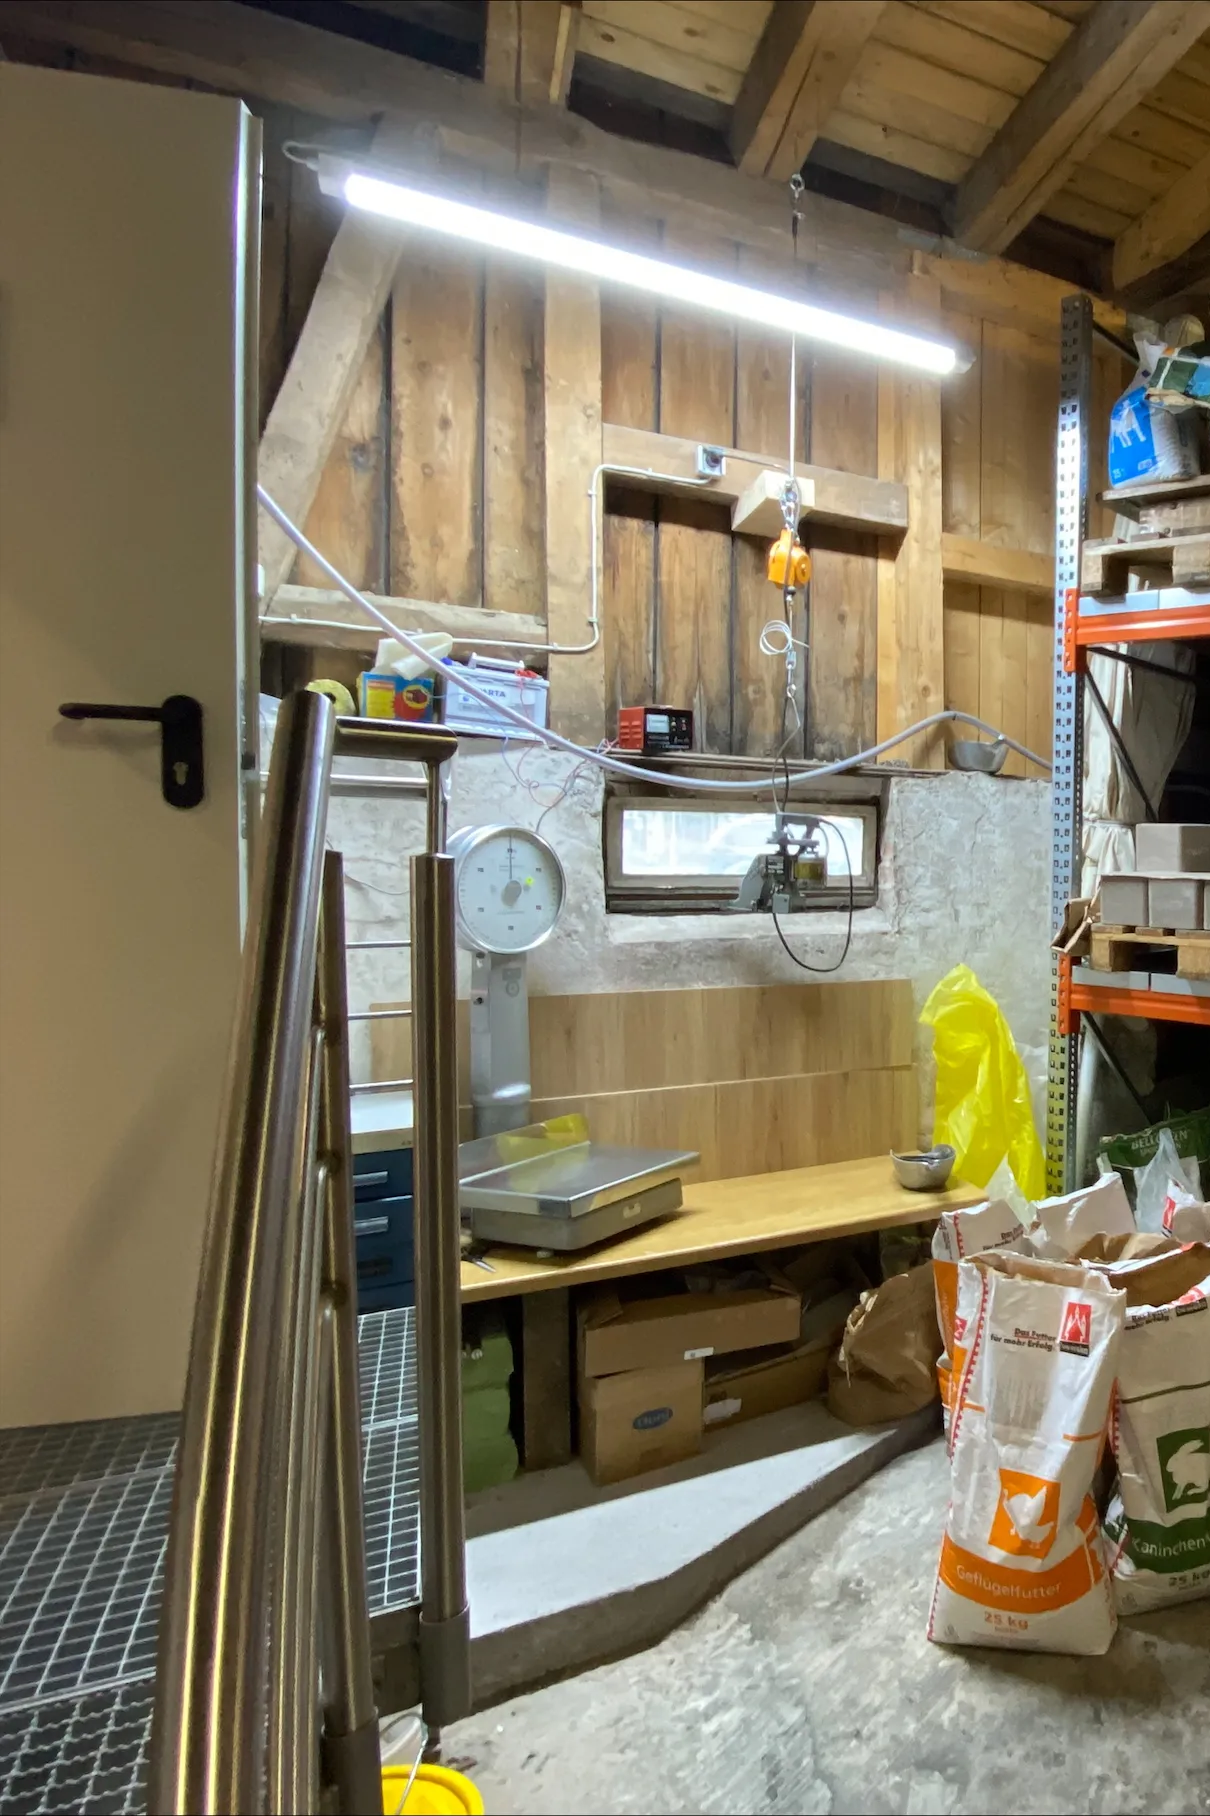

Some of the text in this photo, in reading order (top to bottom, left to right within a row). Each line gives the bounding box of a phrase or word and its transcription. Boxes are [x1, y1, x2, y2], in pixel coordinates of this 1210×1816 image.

[1014, 1327, 1031, 1338] Das
[1003, 1337, 1026, 1348] mehr
[1027, 1340, 1053, 1352] Erfolg
[956, 1564, 1061, 1600] Geflügelfutter
[984, 1611, 1002, 1625] 25
[1008, 1615, 1029, 1631] kg
